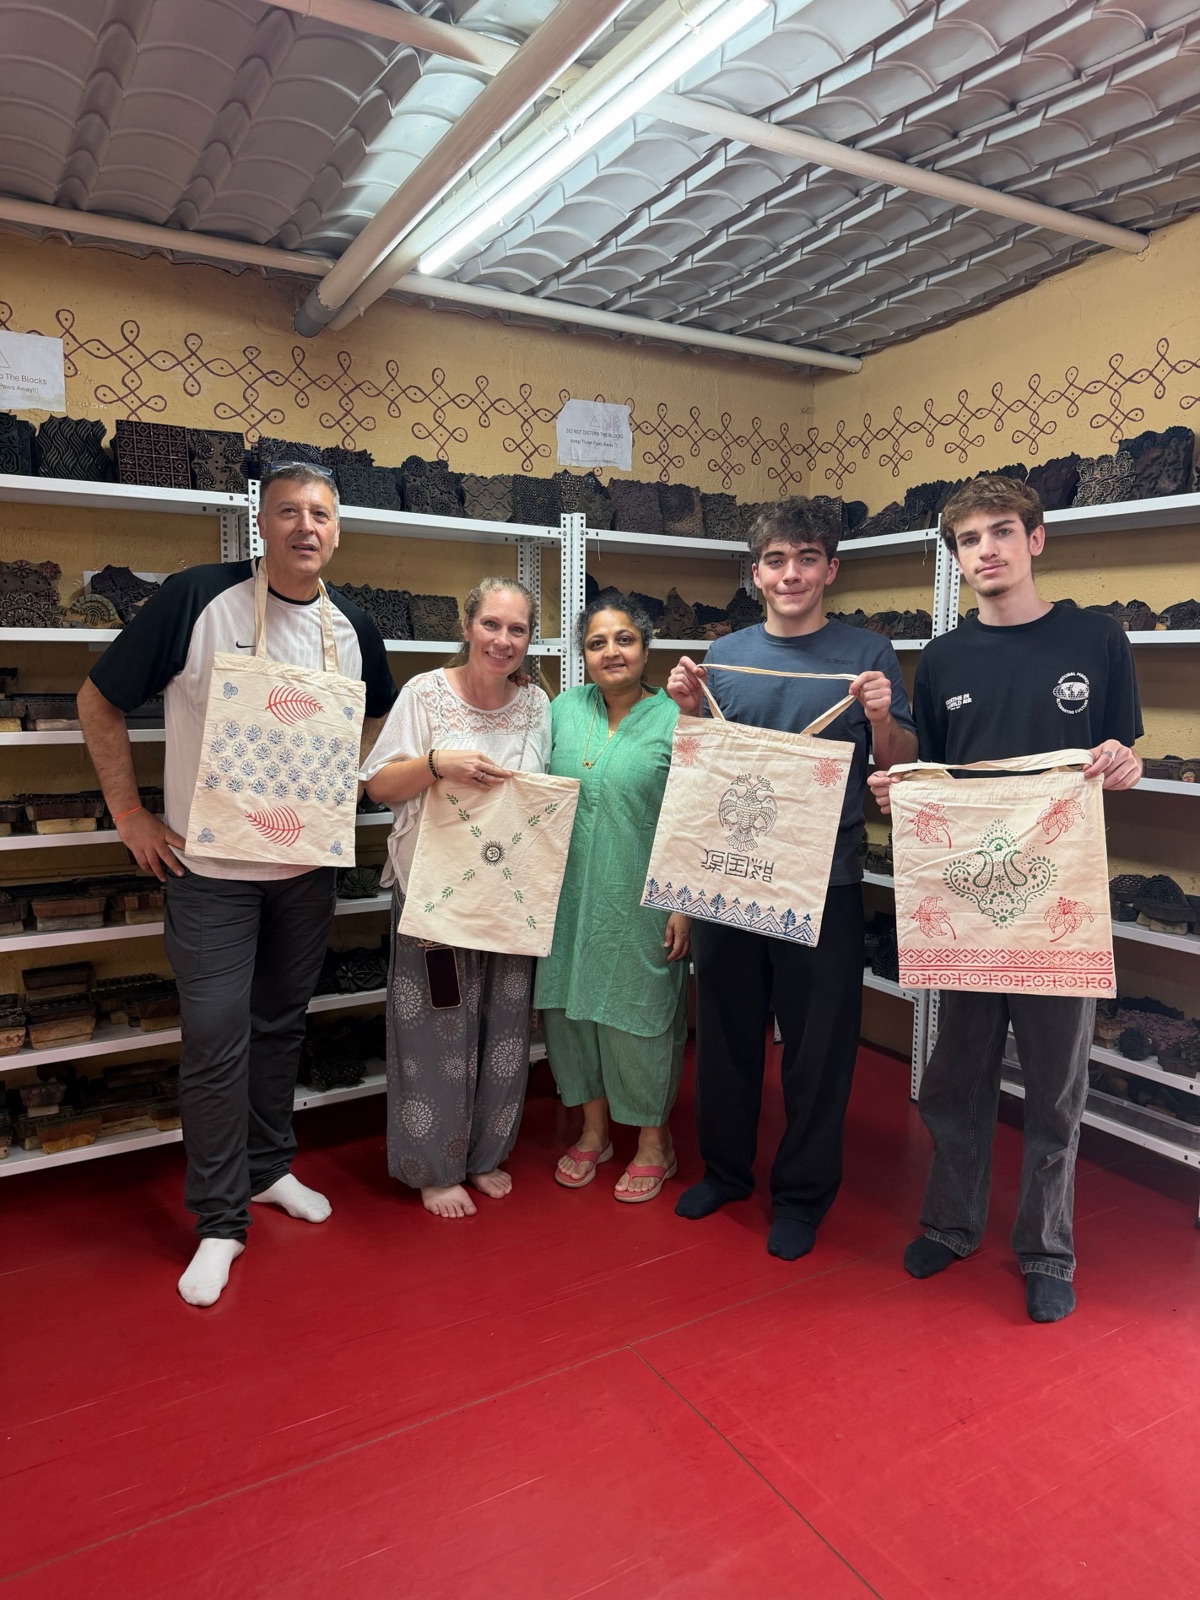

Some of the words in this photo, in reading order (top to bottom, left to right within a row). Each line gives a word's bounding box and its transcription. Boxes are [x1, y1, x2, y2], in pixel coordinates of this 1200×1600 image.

[5, 373, 20, 381] The
[21, 375, 47, 385] Blocks
[1057, 672, 1076, 684] NATURAL
